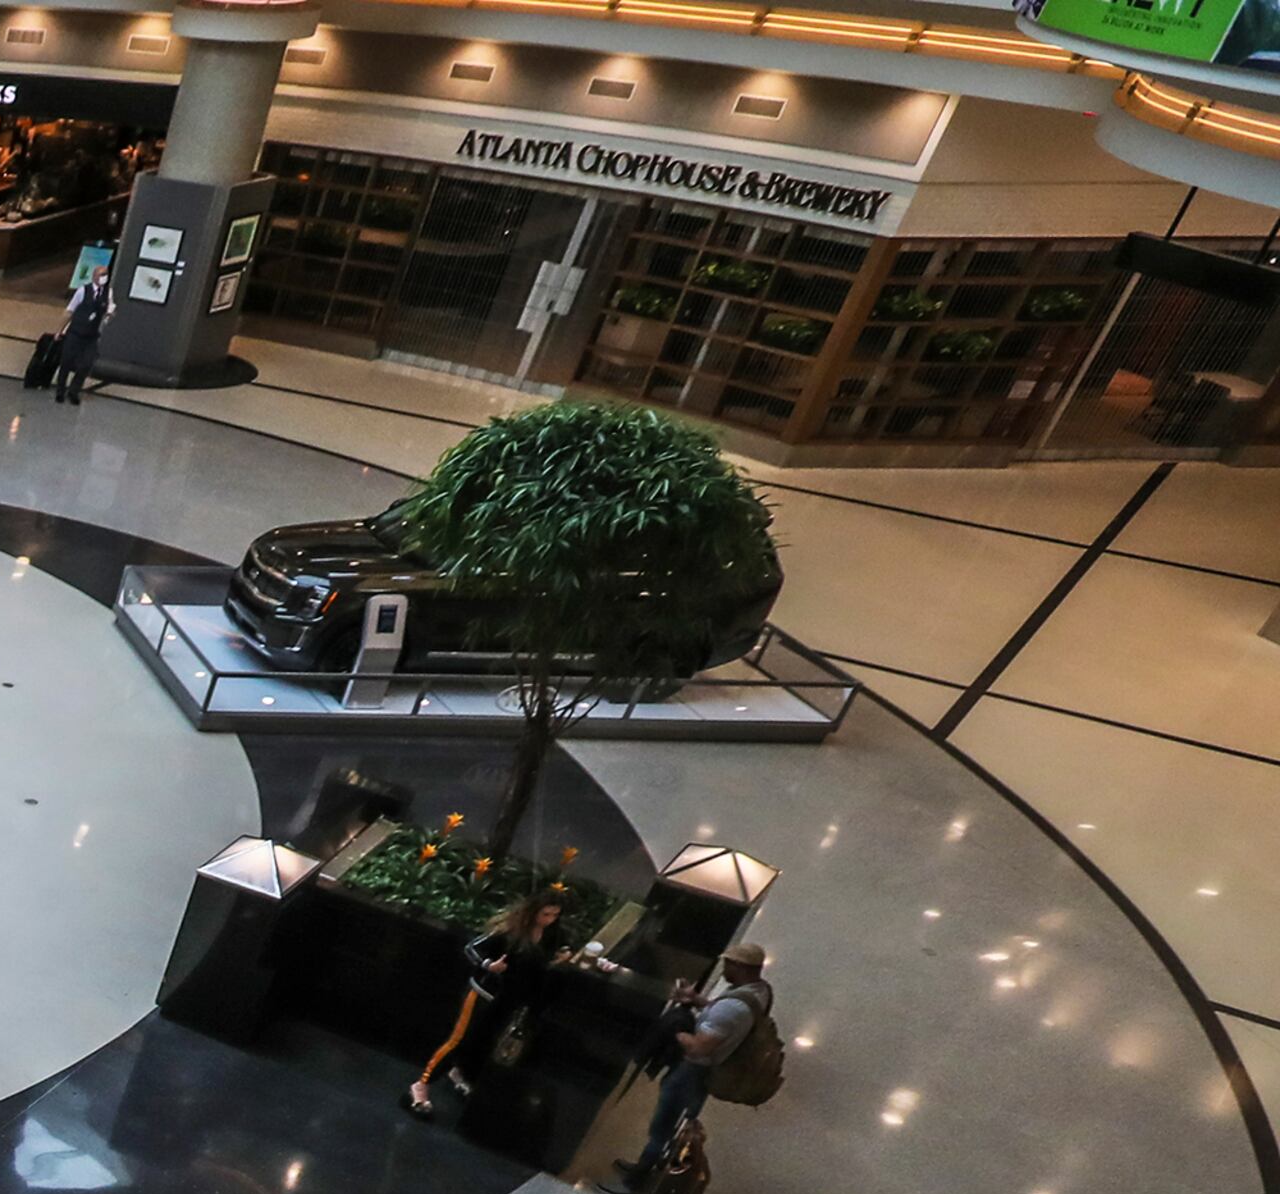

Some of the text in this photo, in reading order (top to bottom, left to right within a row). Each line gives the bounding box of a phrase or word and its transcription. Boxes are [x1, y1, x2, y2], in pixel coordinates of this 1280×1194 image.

[457, 129, 893, 220] ATLANTA CHOPHOUSE & BREWERY
